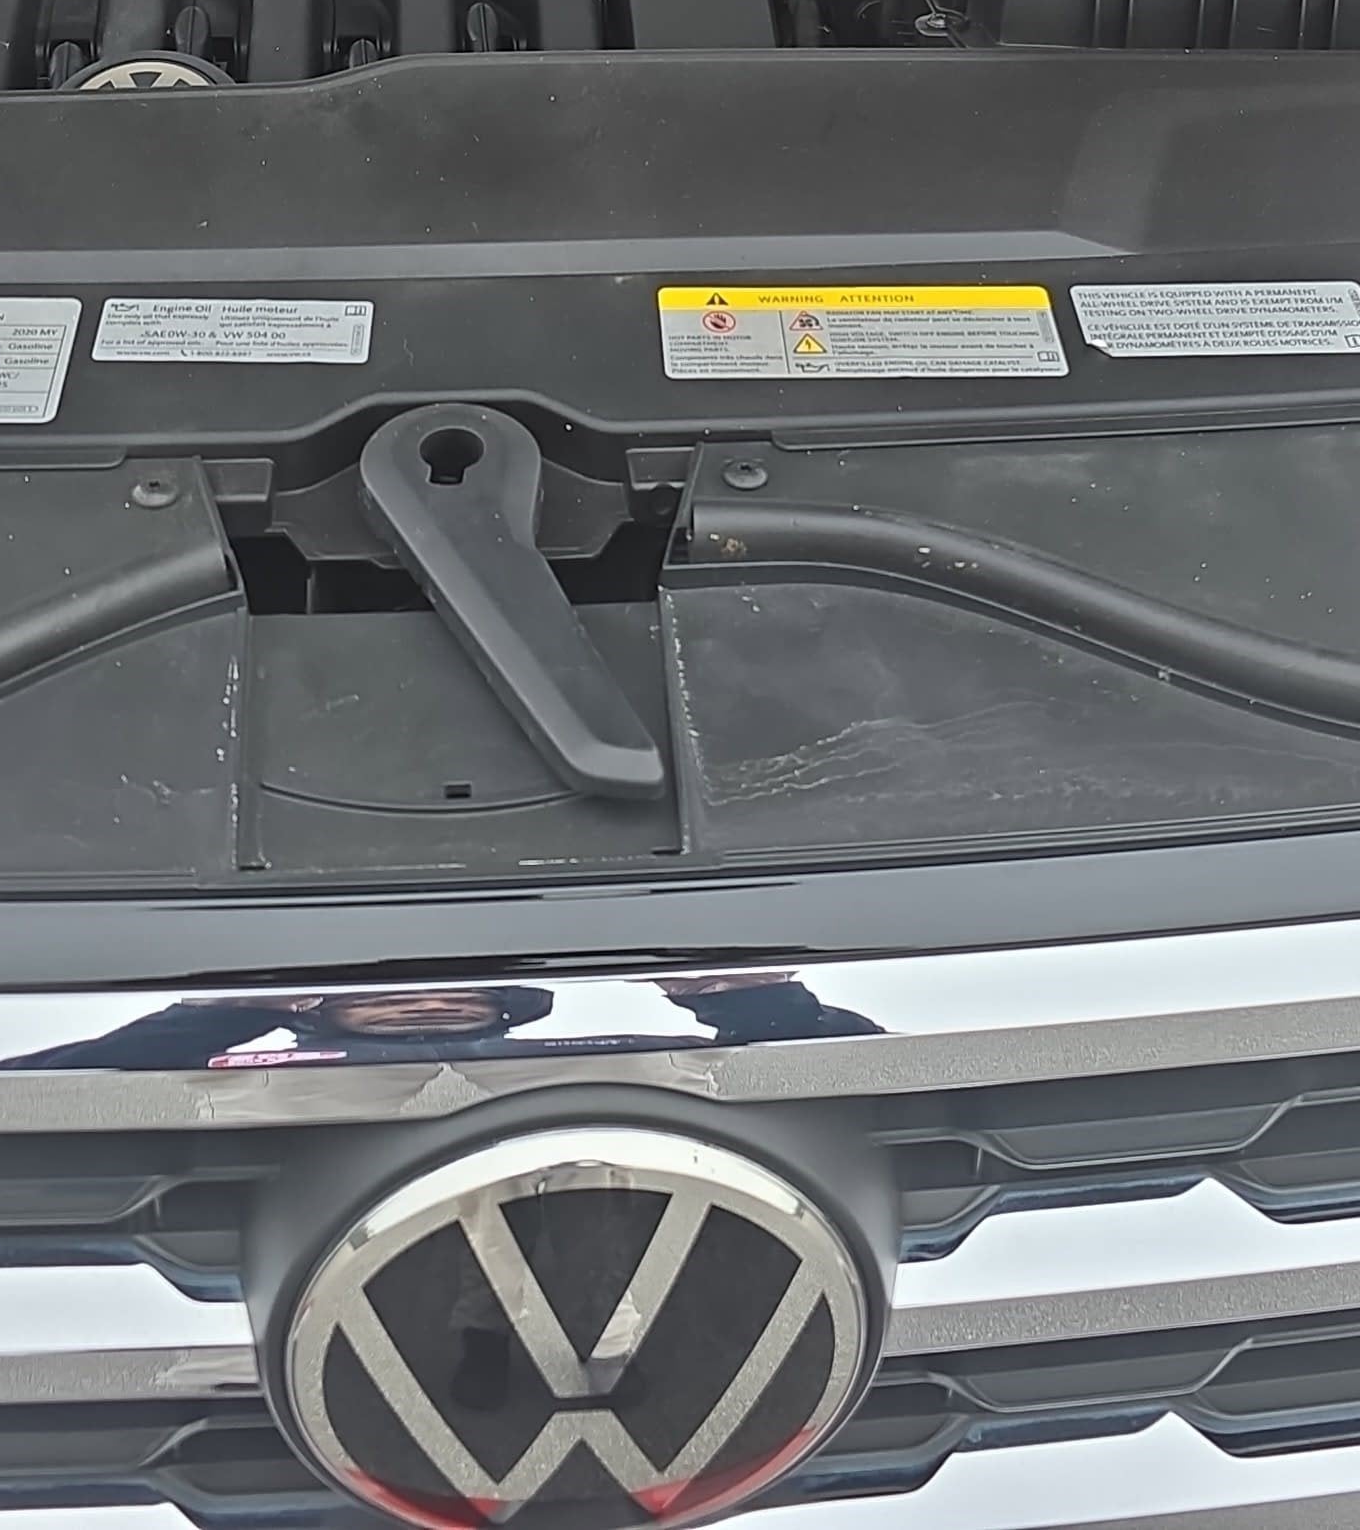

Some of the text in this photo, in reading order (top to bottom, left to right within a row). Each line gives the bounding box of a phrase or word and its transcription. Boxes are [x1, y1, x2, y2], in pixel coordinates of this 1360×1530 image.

[1103, 291, 1145, 299] VEHICLE
[1159, 290, 1212, 298] EQUIPPED
[1254, 288, 1317, 296] PERMANENT
[758, 294, 915, 303] WARNING ATTENTION
[1173, 299, 1212, 307] SYSTEM
[153, 304, 212, 313] Engine Oil
[222, 305, 298, 314] Huile moteur
[1083, 309, 1127, 317] TESTING
[1148, 308, 1214, 316] TWO-WHEEL
[1103, 322, 1151, 331] VÉHICULE
[1174, 321, 1200, 330] DOTÉ
[12, 328, 58, 336] 2020 MY
[223, 331, 244, 339] VW
[246, 331, 268, 339] 504
[1145, 331, 1207, 339] PERMANENT
[1213, 339, 1242, 347] DEUX
[4, 357, 49, 365] Gasoline
[288, 1125, 872, 1530] VW
